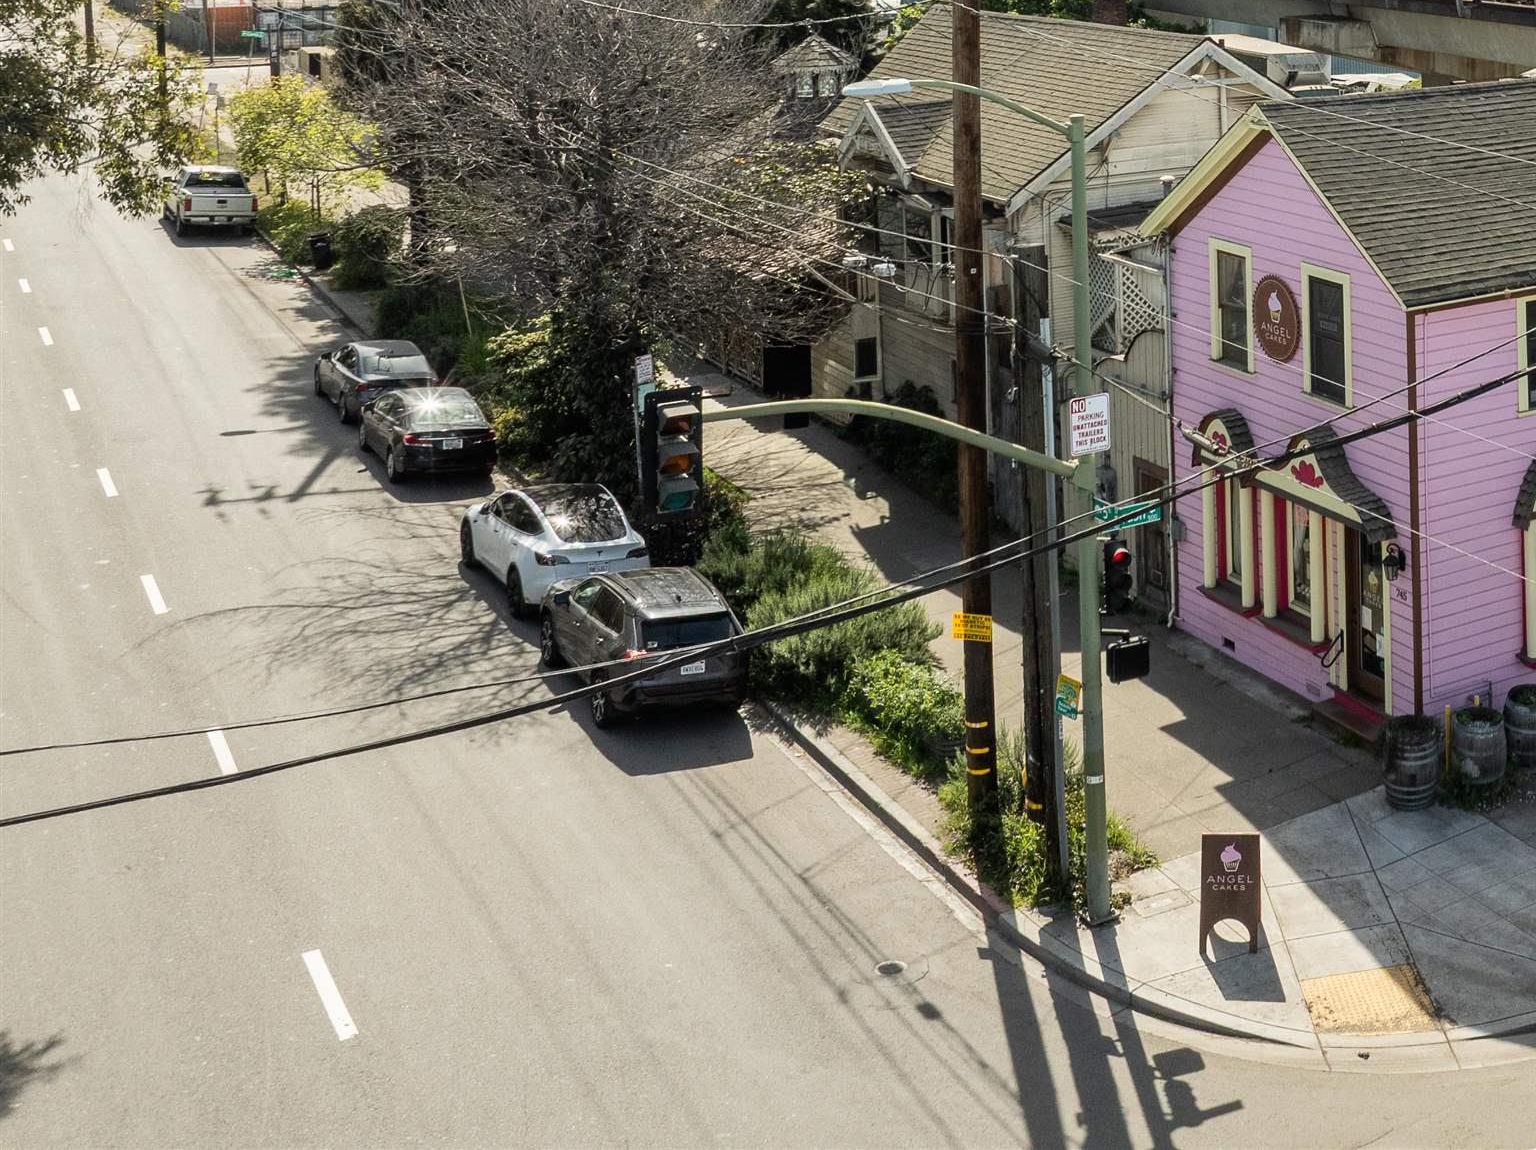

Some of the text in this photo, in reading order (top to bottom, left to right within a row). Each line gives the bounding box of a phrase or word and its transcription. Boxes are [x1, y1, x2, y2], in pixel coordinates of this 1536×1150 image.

[1261, 321, 1291, 339] ANGEL
[1265, 332, 1287, 345] CAKES
[1072, 400, 1085, 413] NO
[1078, 411, 1104, 421] PARKING
[1073, 420, 1107, 431] UNATTACHED
[1078, 428, 1104, 438] TRAILERS
[1076, 436, 1106, 447] THIS BLOCK
[1396, 588, 1408, 601] 745
[1207, 875, 1255, 884] ANGEL
